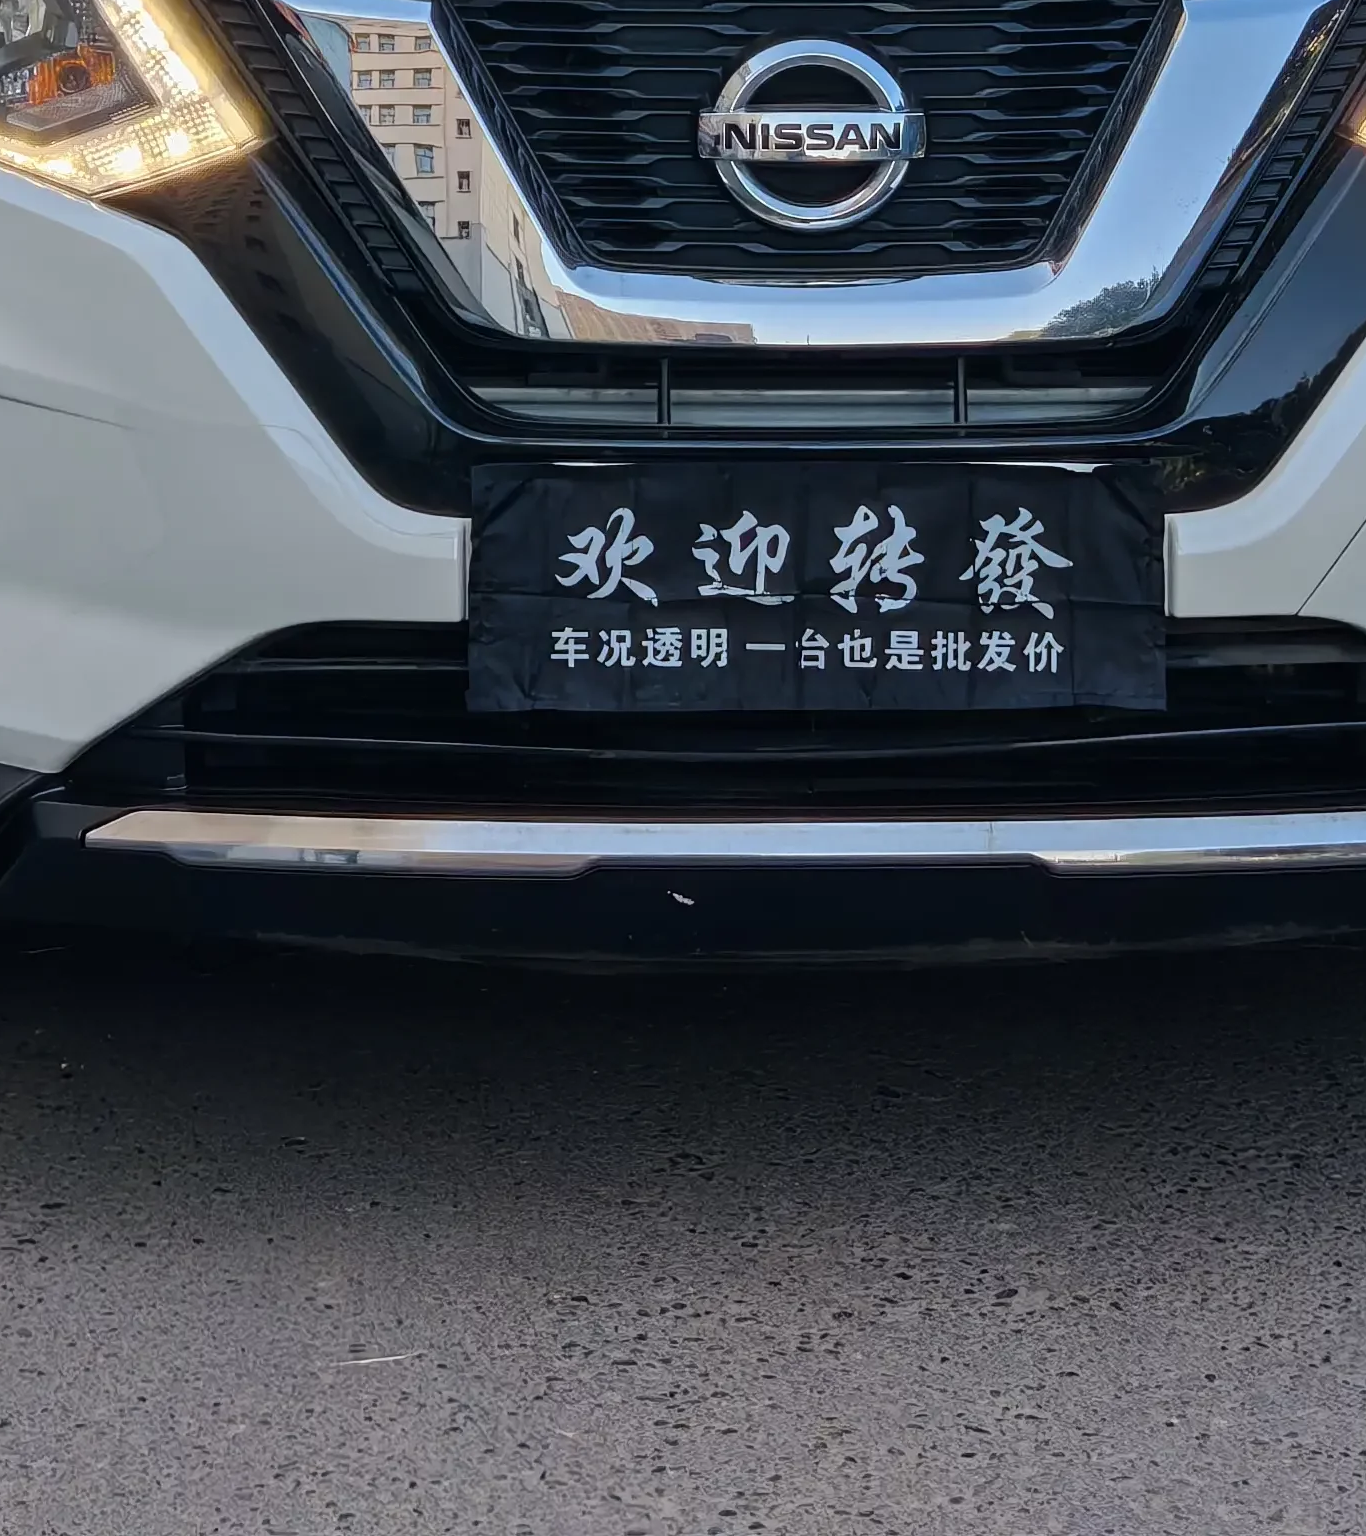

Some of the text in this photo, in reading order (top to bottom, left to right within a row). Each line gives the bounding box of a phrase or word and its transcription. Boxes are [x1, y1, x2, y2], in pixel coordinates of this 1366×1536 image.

[723, 122, 902, 151] NISSAN
[554, 505, 1073, 619] 欢迎转發
[550, 626, 1065, 673] 车况透明一台也是批发价
